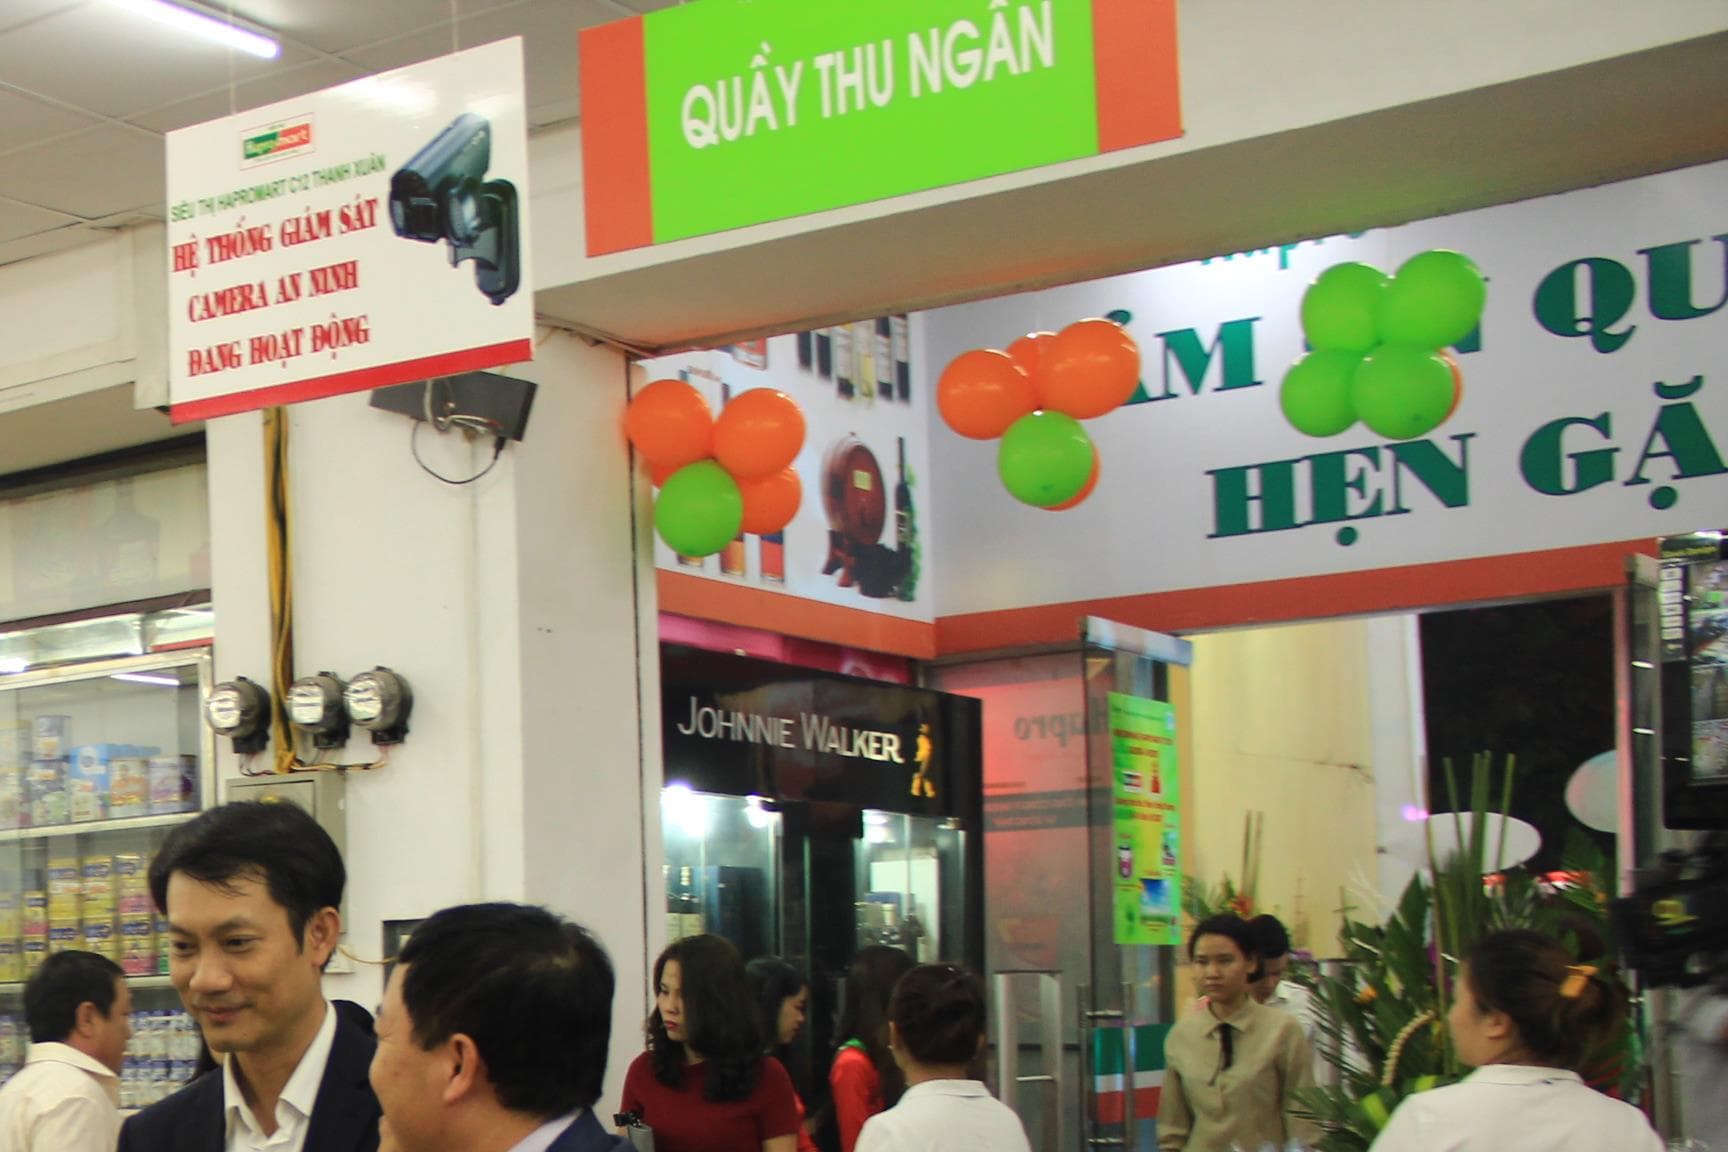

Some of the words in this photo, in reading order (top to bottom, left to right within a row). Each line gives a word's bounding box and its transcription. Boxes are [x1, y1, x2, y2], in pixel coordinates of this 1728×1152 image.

[680, 40, 803, 150] QUẦY
[814, 39, 893, 119] THU
[910, 1, 1056, 98] NGÂN
[172, 233, 198, 278] HỆ
[206, 215, 273, 264] THỐNG
[281, 206, 333, 247] GIÁM
[339, 194, 379, 234] SÁT
[188, 281, 269, 323] CAMERA
[275, 272, 303, 304] AN
[308, 259, 359, 298] NINH
[250, 328, 304, 368] HOẠT
[310, 313, 370, 360] ĐỘNG
[1205, 434, 1477, 547] HẸN
[677, 696, 795, 749] JOHNNIE
[800, 712, 905, 765] WALKER
